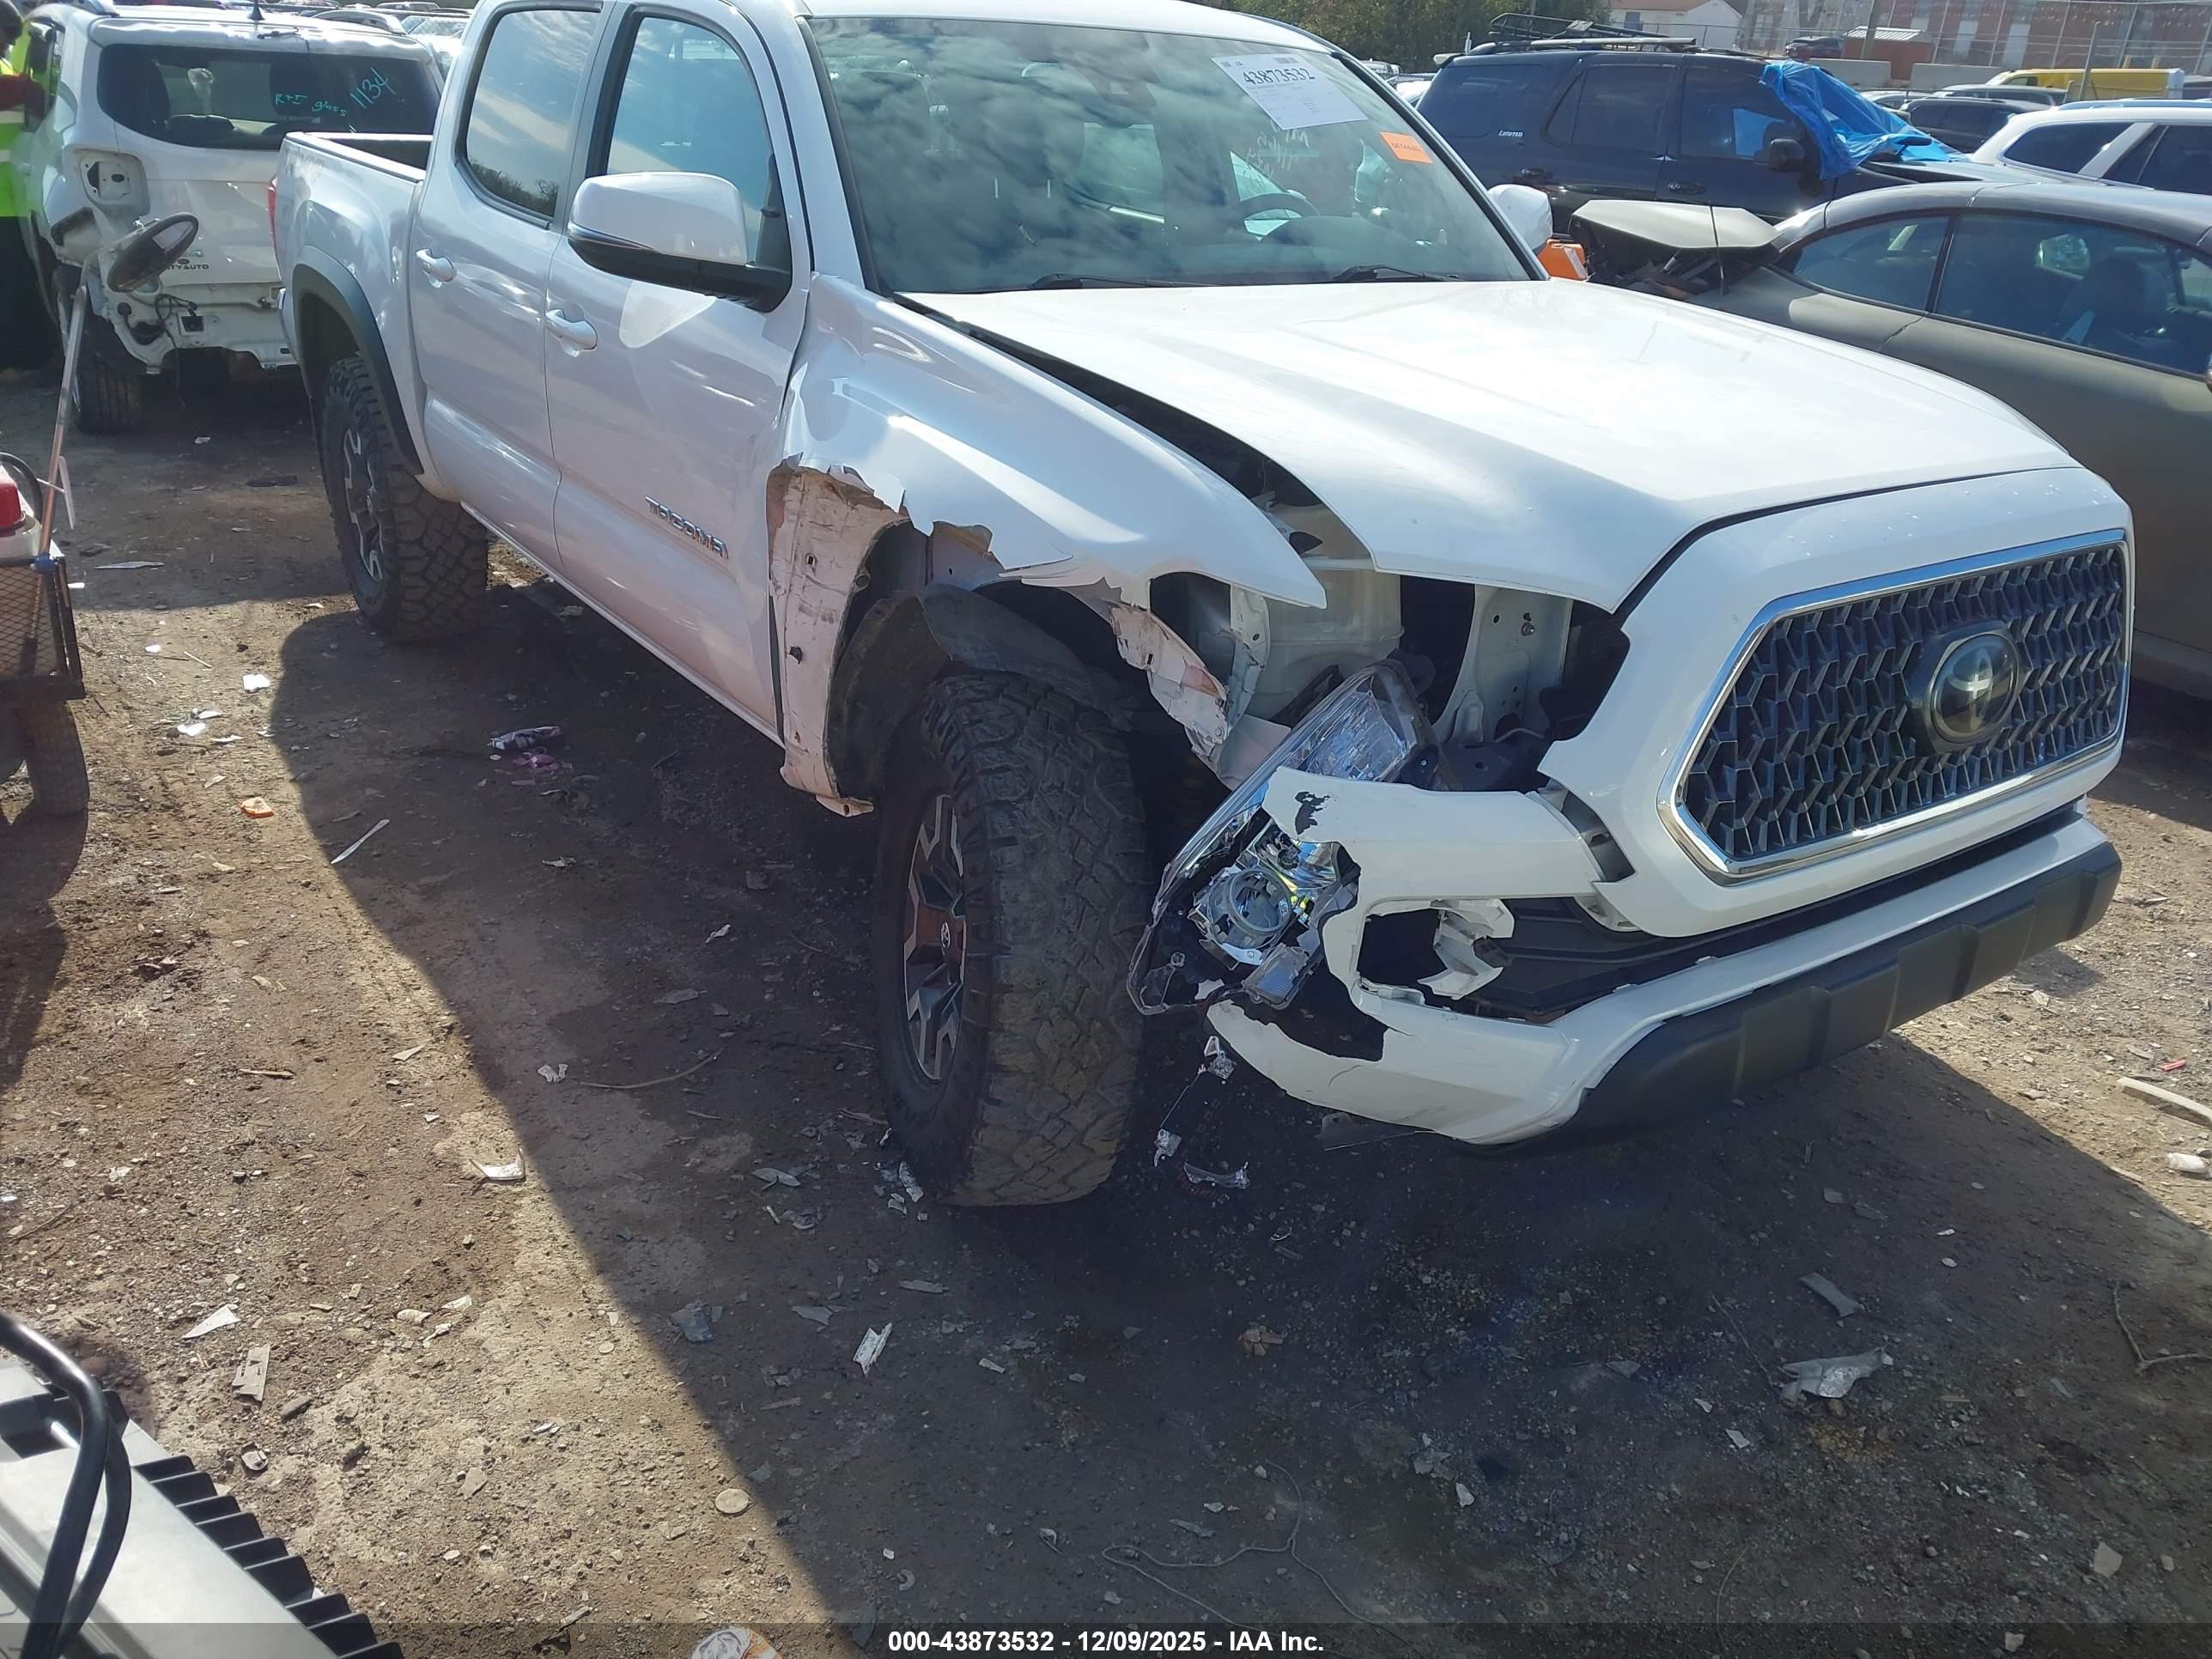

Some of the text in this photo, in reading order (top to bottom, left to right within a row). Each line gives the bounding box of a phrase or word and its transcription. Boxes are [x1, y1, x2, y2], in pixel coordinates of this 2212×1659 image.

[349, 66, 397, 109] 1134
[1243, 68, 1316, 85] 43873532
[645, 495, 729, 560] TACOMA
